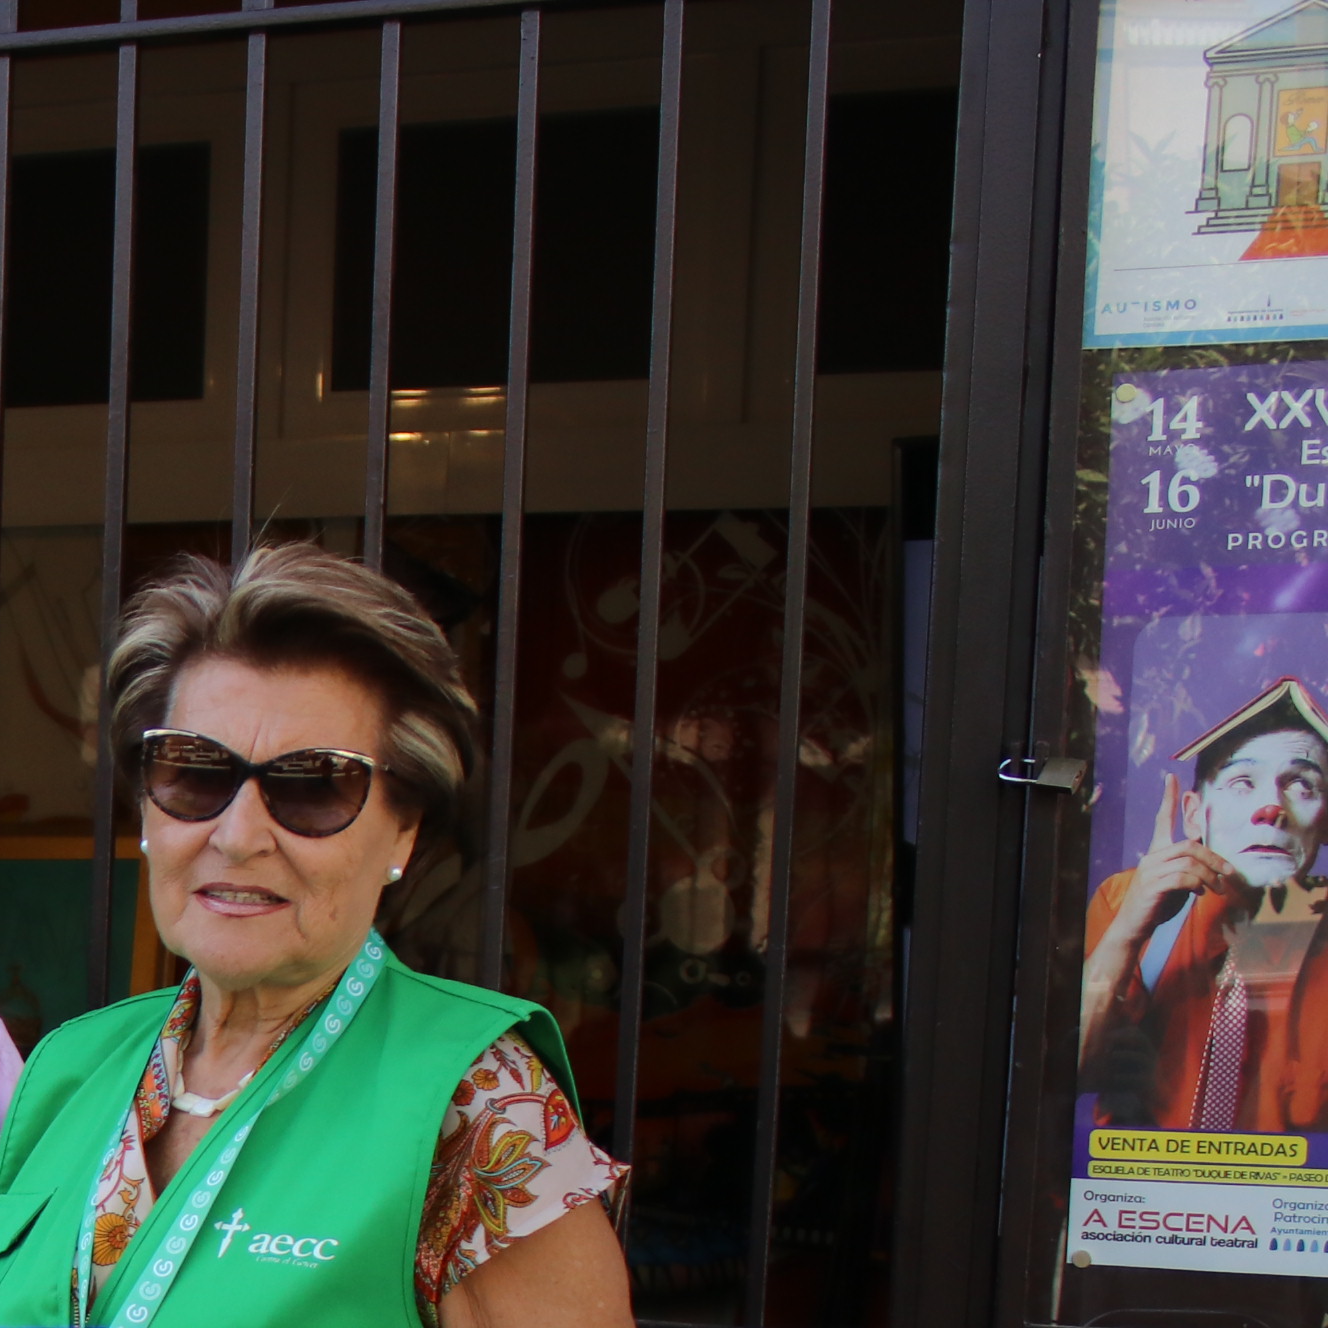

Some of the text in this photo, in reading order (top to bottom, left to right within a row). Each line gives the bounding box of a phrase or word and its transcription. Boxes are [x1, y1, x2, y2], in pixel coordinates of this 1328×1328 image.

[1145, 395, 1202, 441] 14
[1141, 469, 1200, 514] 16
[1246, 474, 1326, 510] "Du
[1150, 518, 1195, 531] JUNIO
[1098, 1137, 1299, 1158] VENTA DE ENTRADAS
[1092, 1165, 1323, 1183] ESCUELA DE TEATRO DE PASEO
[1084, 1190, 1146, 1204] Organiza:
[1082, 1209, 1256, 1235] A ESCENA
[248, 1234, 339, 1260] aecc
[1081, 1231, 1258, 1249] asociación cultural teatral
